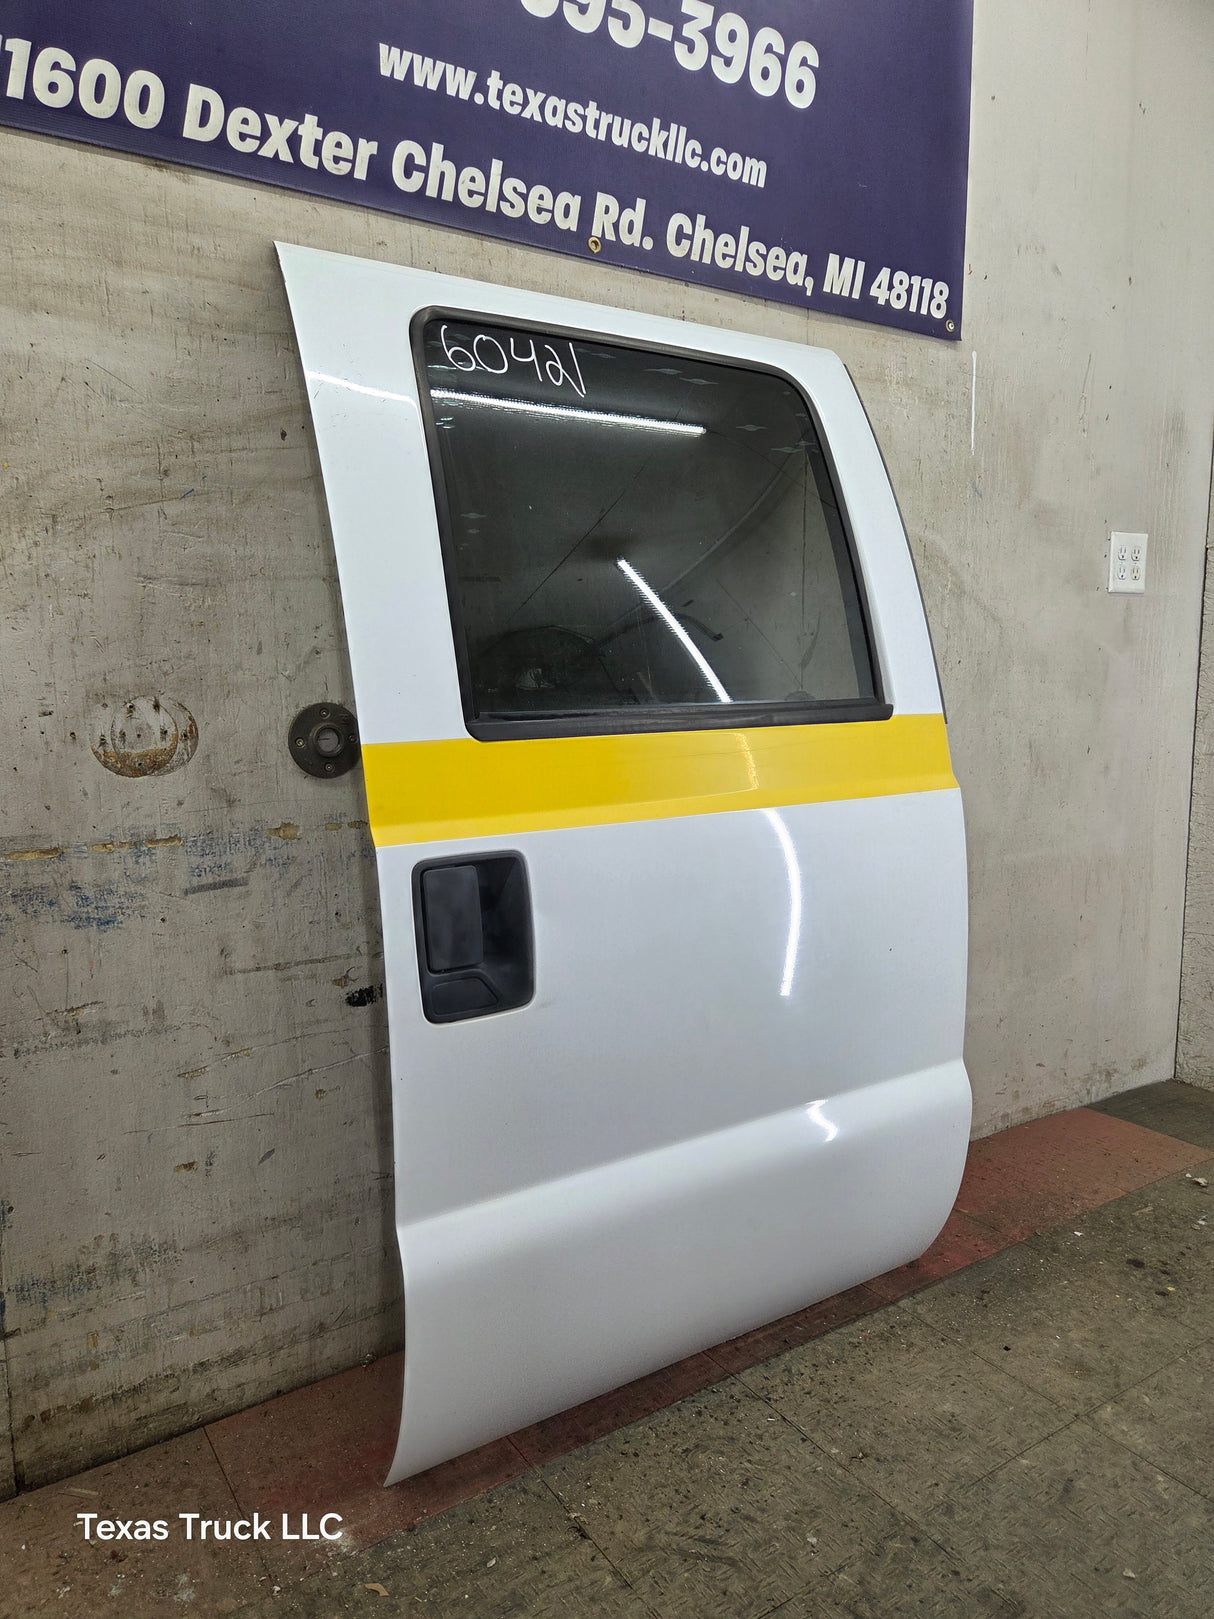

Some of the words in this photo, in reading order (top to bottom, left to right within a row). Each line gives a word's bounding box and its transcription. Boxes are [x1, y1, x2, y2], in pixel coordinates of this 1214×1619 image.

[378, 42, 767, 188] www.texastruckllc.com
[521, 0, 820, 109] 5-3966
[0, 34, 165, 130] 1600
[183, 84, 378, 181] Dexter
[391, 139, 582, 232] Chelsea
[592, 191, 653, 251] Rd.
[666, 212, 813, 296] Chelsea,
[823, 252, 866, 300] MI
[869, 266, 950, 319] 48118
[440, 324, 587, 398] 60421
